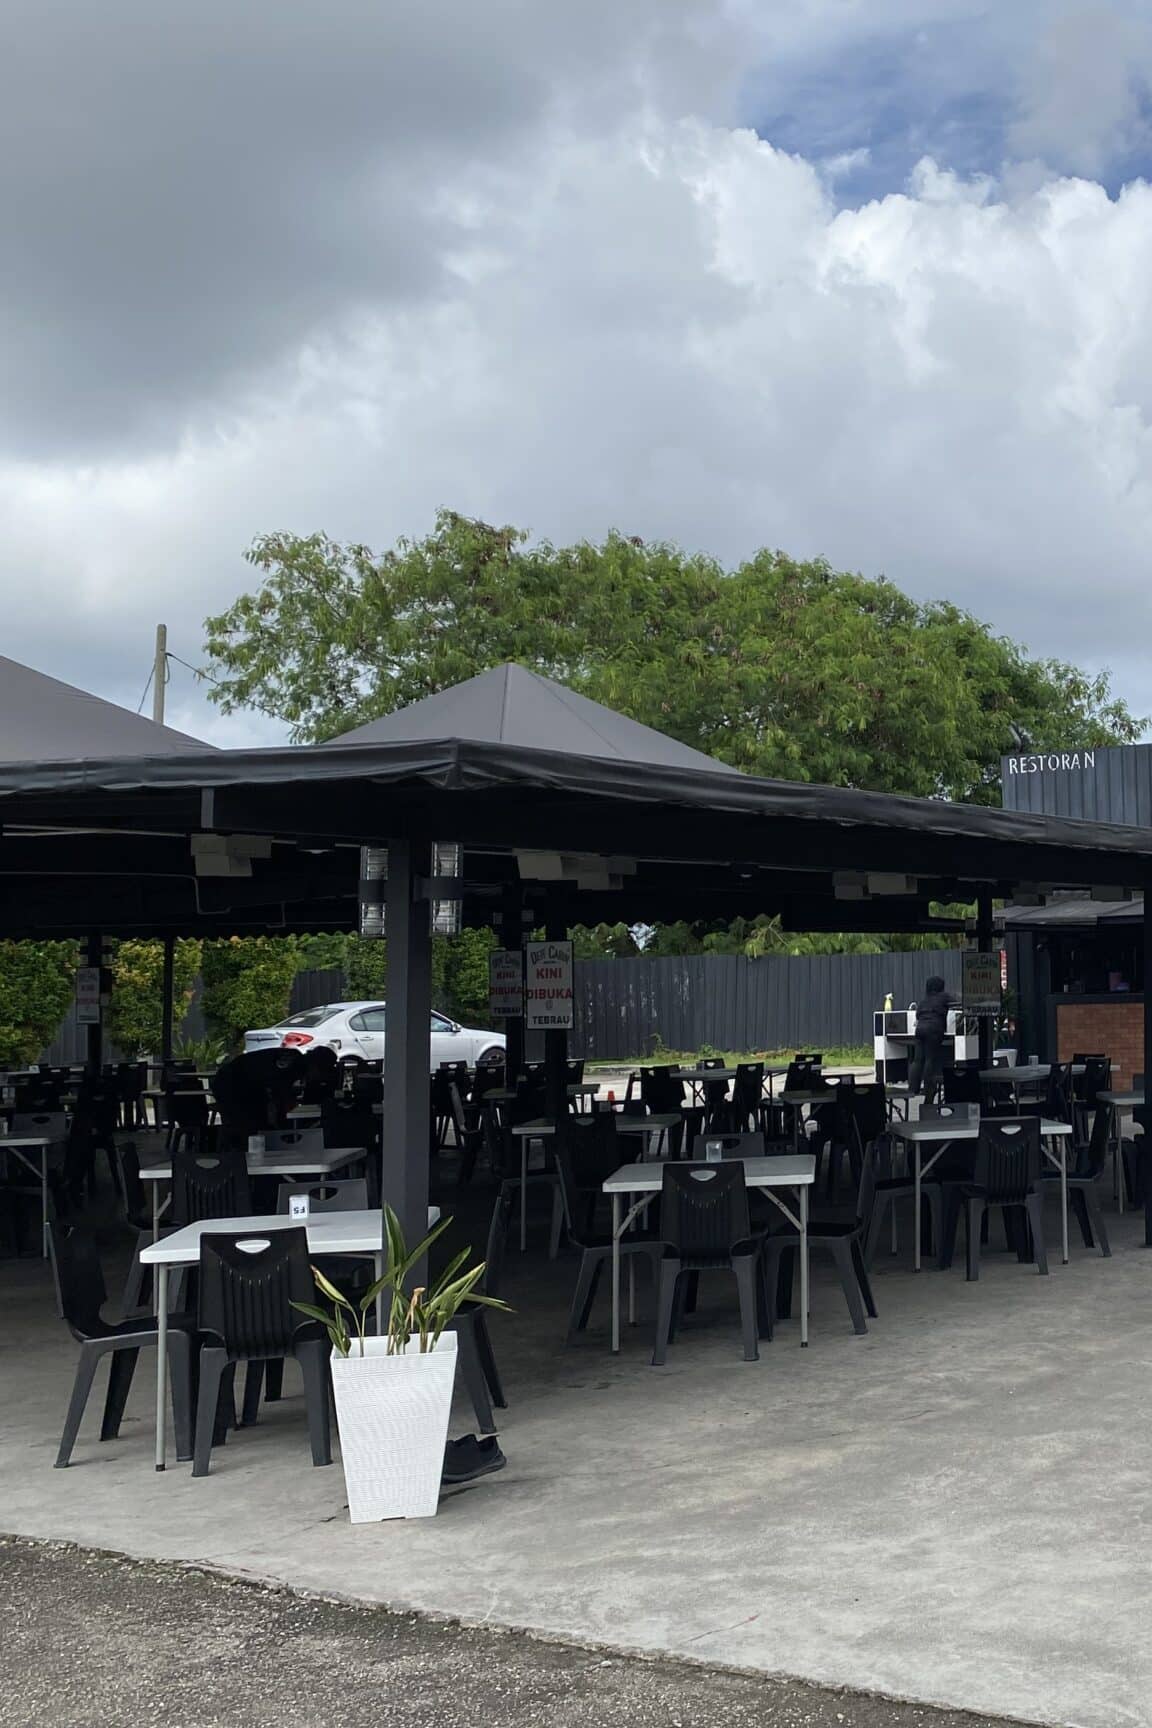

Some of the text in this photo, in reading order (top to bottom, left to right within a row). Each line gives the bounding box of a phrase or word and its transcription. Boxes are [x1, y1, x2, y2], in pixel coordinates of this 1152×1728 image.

[1008, 751, 1095, 775] RESTORAN
[536, 967, 562, 979] KINI
[527, 989, 573, 1000] DIBUKA
[532, 1015, 570, 1025] TEBRAU
